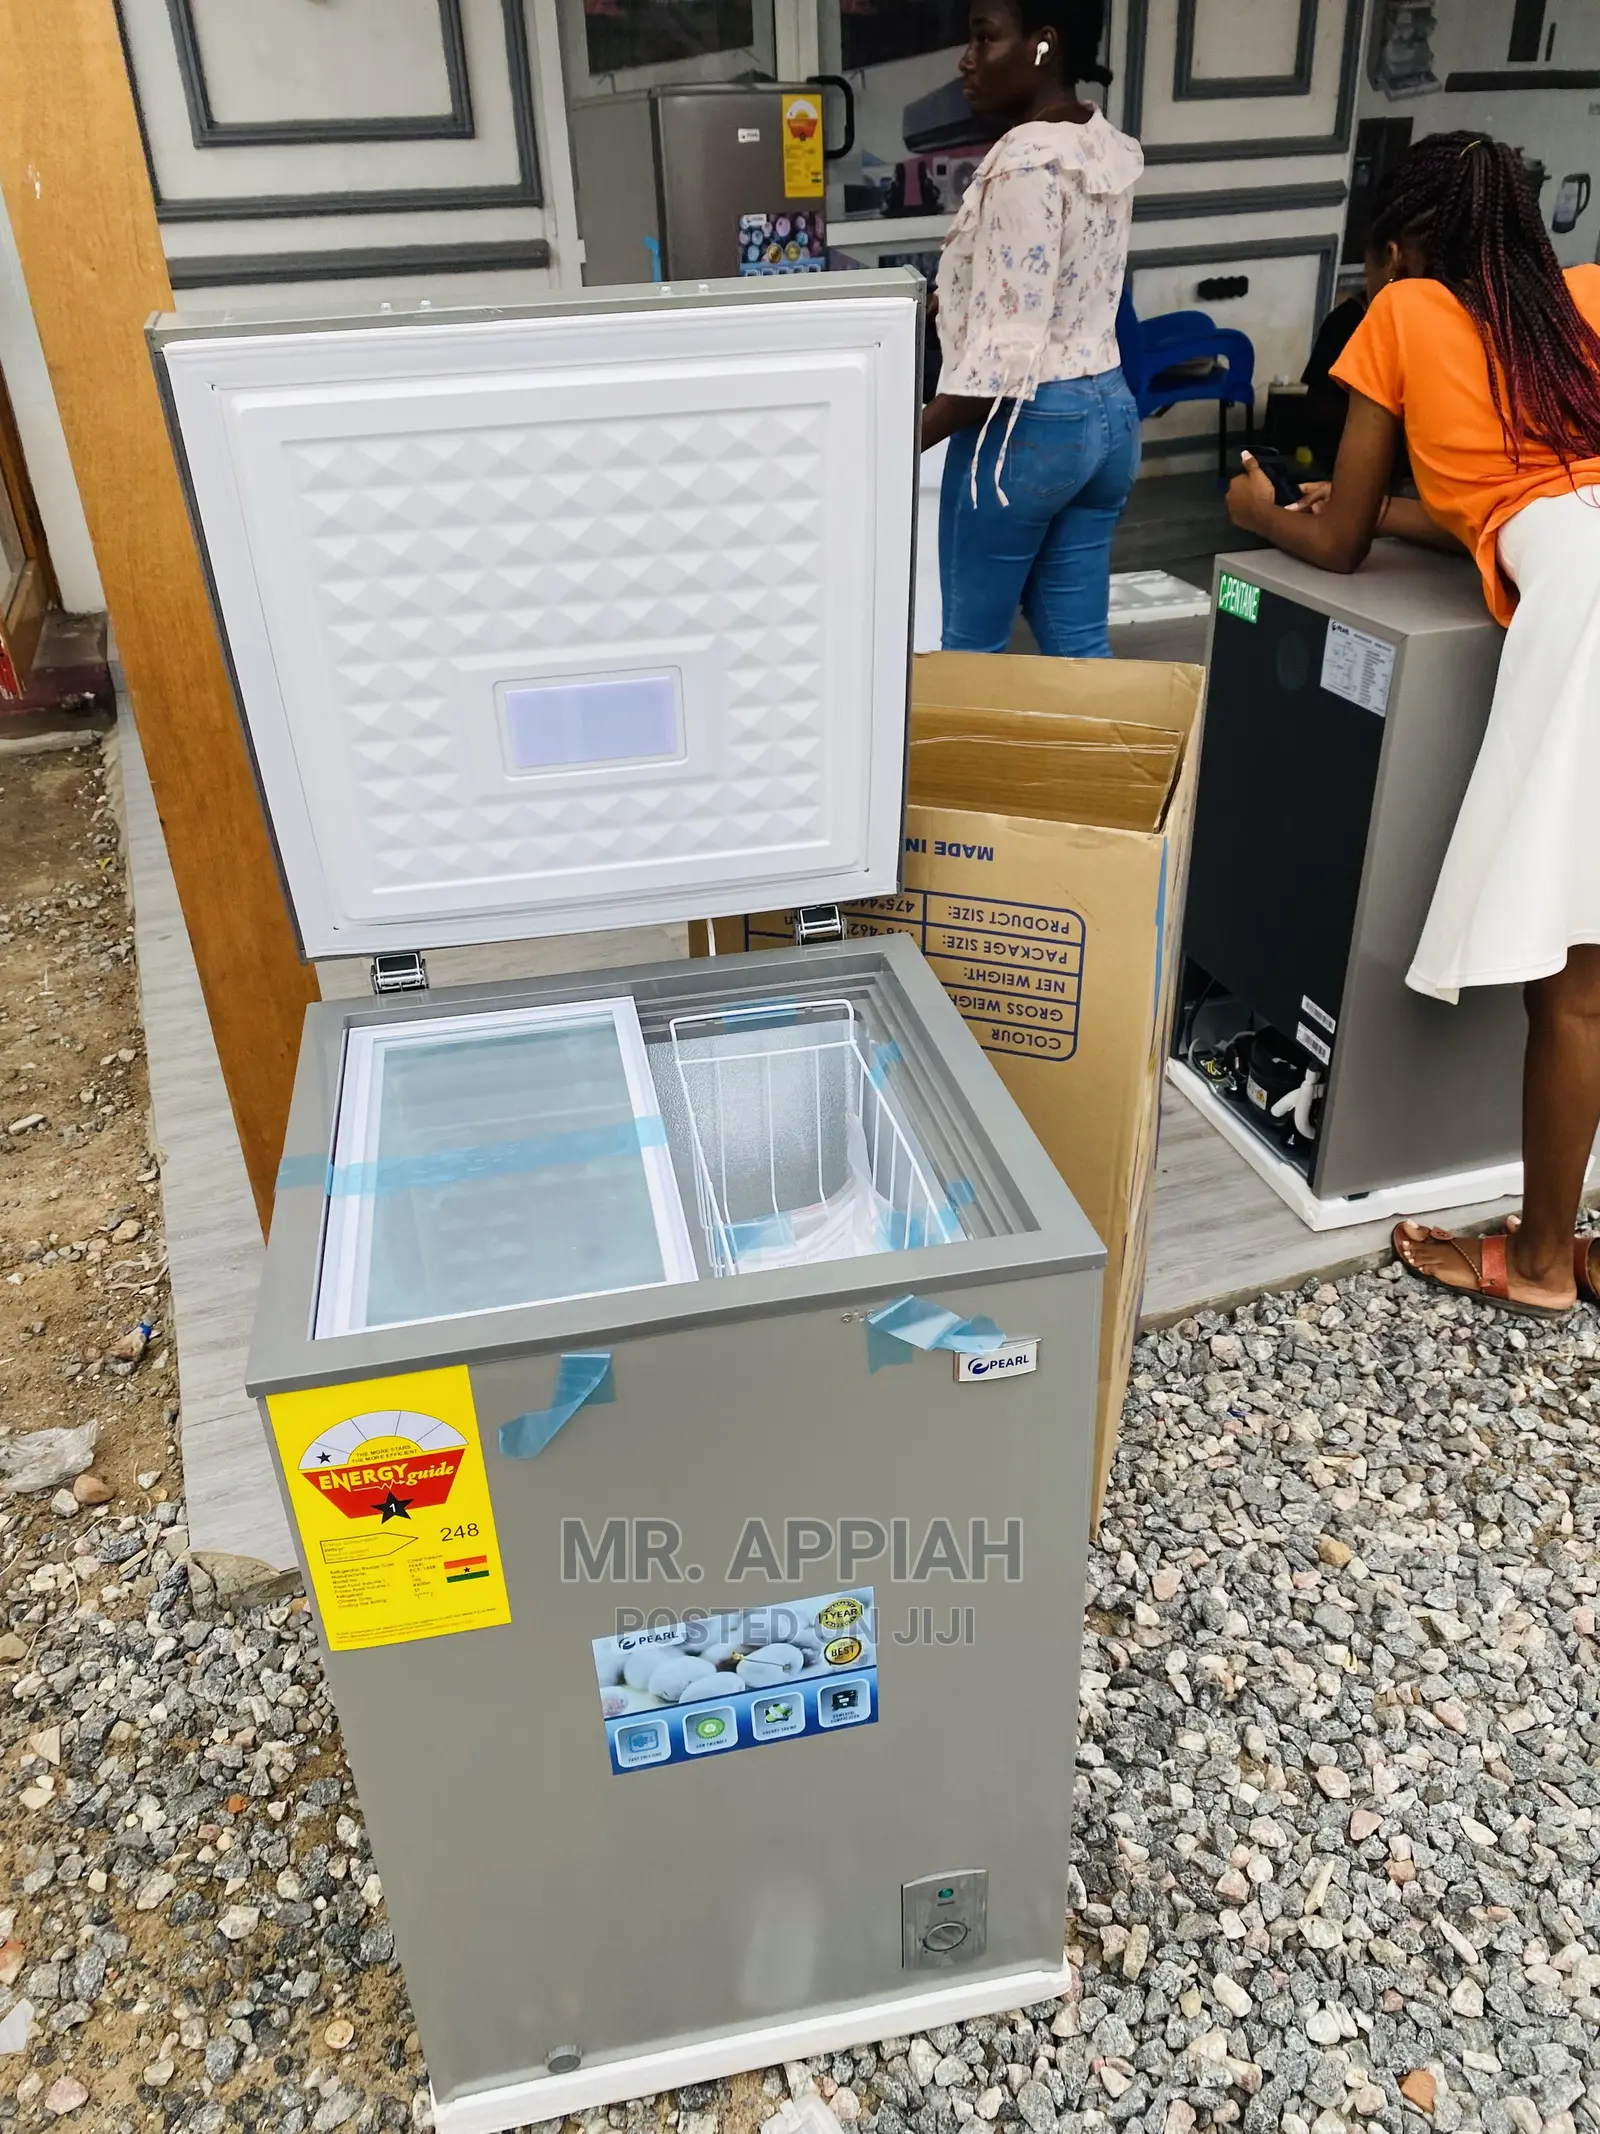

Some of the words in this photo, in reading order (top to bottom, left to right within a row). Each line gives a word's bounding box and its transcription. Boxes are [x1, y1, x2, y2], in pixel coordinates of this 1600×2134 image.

[1219, 574, 1260, 619] C-PENTANE
[905, 838, 929, 855] IN
[934, 841, 994, 862] MADE
[948, 904, 986, 924] SIZE:
[989, 910, 1070, 935] PRODUCT
[942, 934, 980, 954] SIZE:
[984, 940, 1068, 965] PACKAGE
[963, 966, 1031, 989] WEIGHT:
[1035, 977, 1066, 994] NET
[1005, 1002, 1063, 1023] GROSS
[991, 1028, 1062, 1051] COLOUR
[989, 1354, 1030, 1370] PEARL
[352, 1456, 366, 1464] THE
[365, 1454, 384, 1462] MORE
[386, 1449, 418, 1459] EFFICIENT
[356, 1450, 371, 1458] THE
[371, 1447, 389, 1456] MORE
[390, 1445, 412, 1453] STARS
[319, 1463, 408, 1493] ENERGY
[406, 1461, 455, 1487] guide
[389, 1503, 396, 1513] 1
[440, 1523, 480, 1542] 248
[830, 1608, 858, 1619] YEAR
[638, 1629, 679, 1646] PEARL
[831, 1645, 855, 1658] BEST
